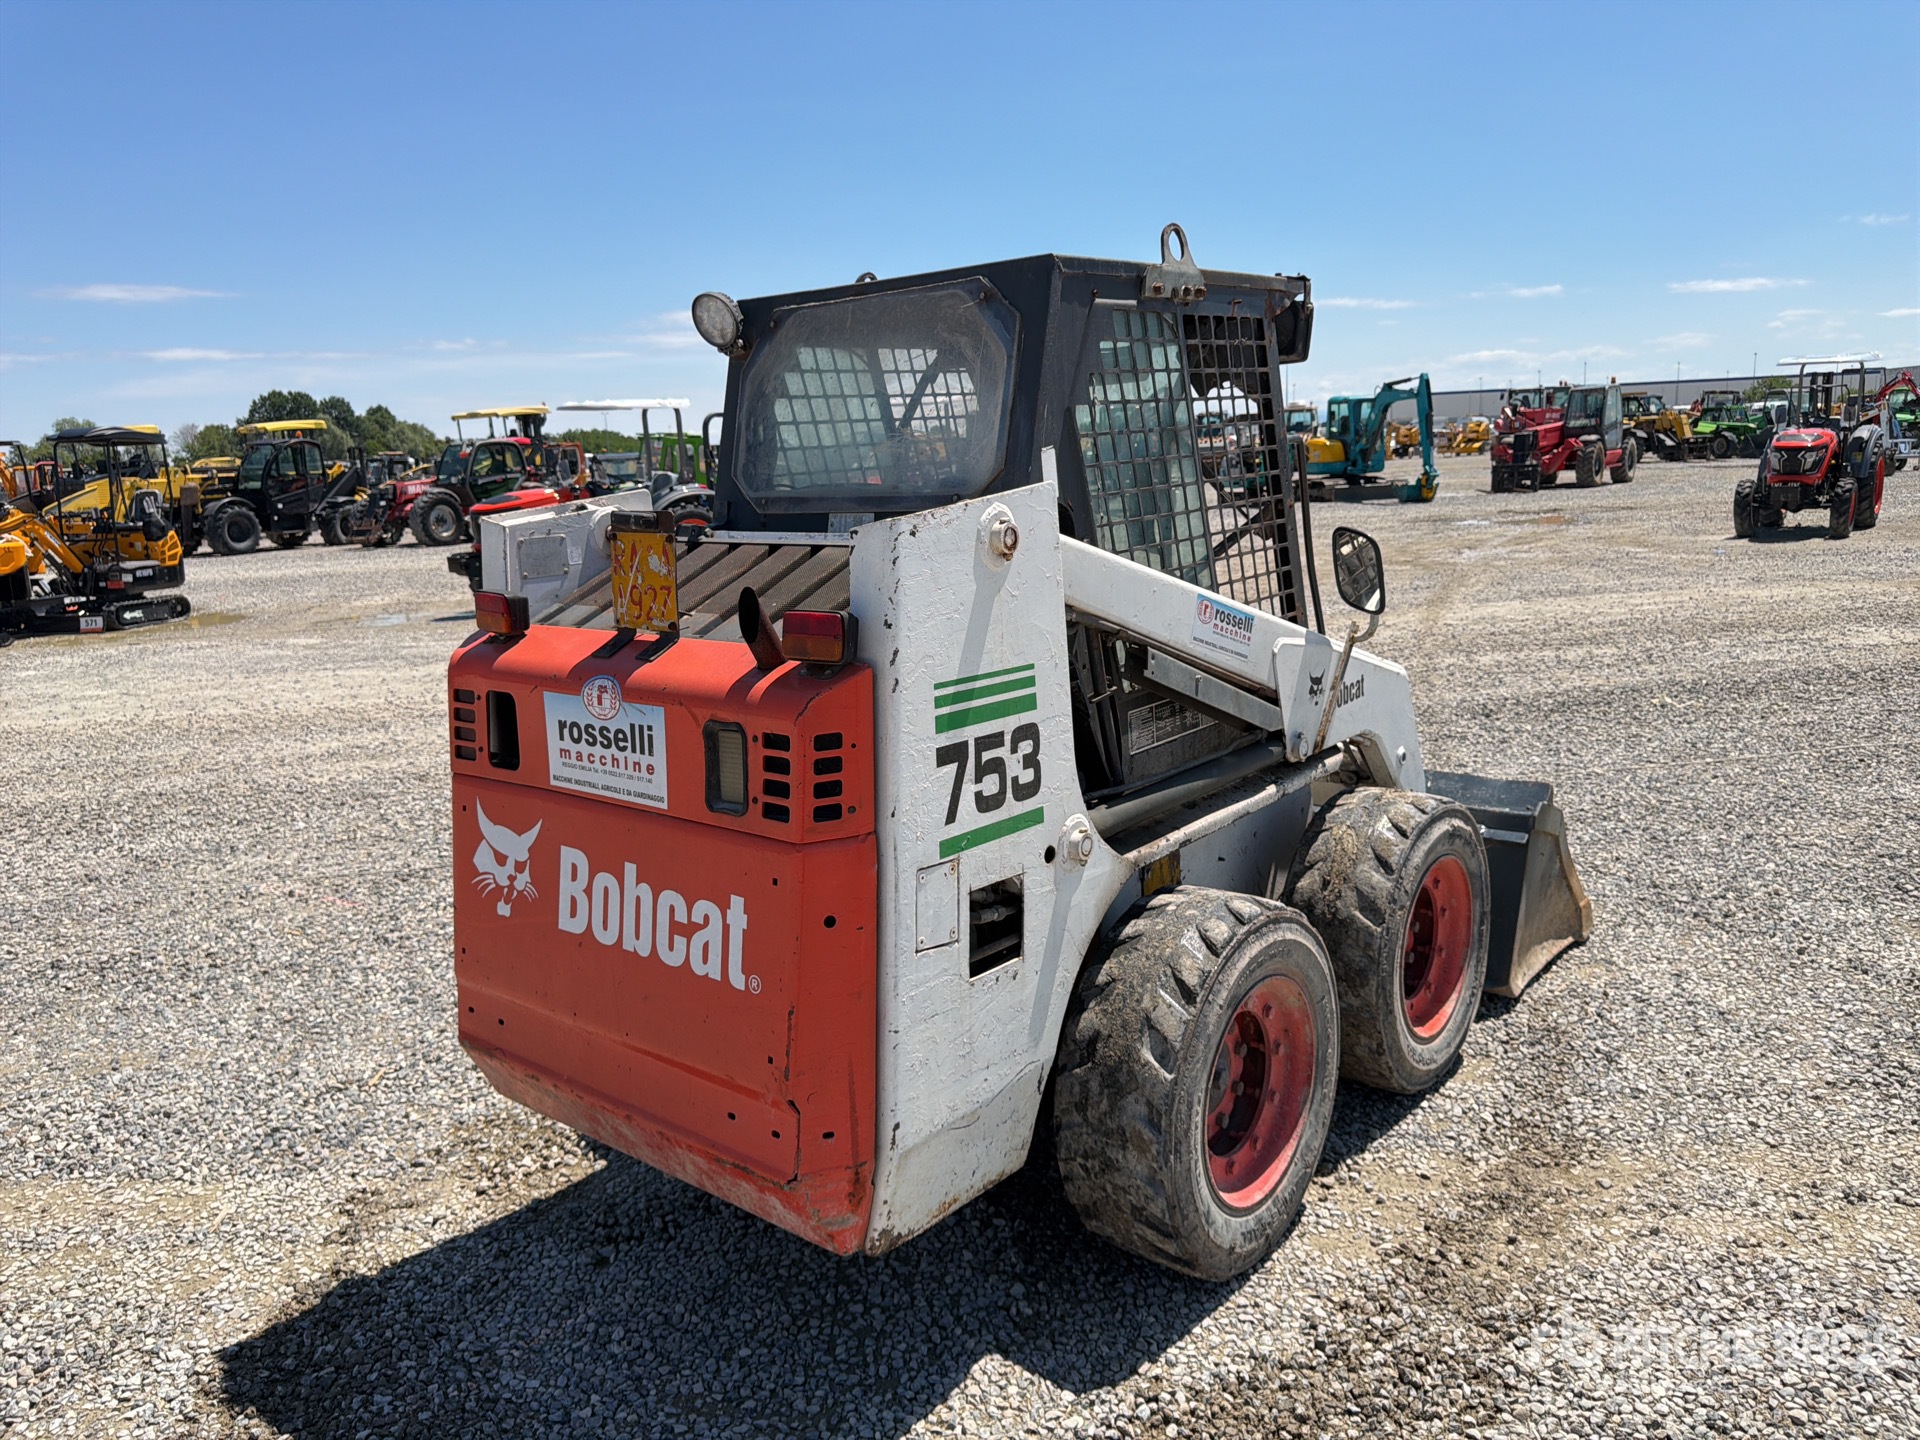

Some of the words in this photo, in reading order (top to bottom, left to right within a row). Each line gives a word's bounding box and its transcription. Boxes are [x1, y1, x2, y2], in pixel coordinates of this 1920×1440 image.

[85, 619, 98, 628] 571
[1212, 623, 1251, 643] macchine
[1214, 608, 1254, 634] rosselli
[1336, 674, 1365, 708] obcat
[558, 719, 655, 757] rosselli
[559, 747, 656, 776] macchine
[578, 764, 592, 773] EMILIA
[935, 721, 1042, 826] 753
[552, 774, 573, 785] MACCHINE
[573, 778, 600, 790] INDUSTRIALI,
[600, 784, 622, 795] AGRICOLE
[633, 790, 665, 804] GIARDINAGGIO
[558, 844, 749, 991] Bobcat
